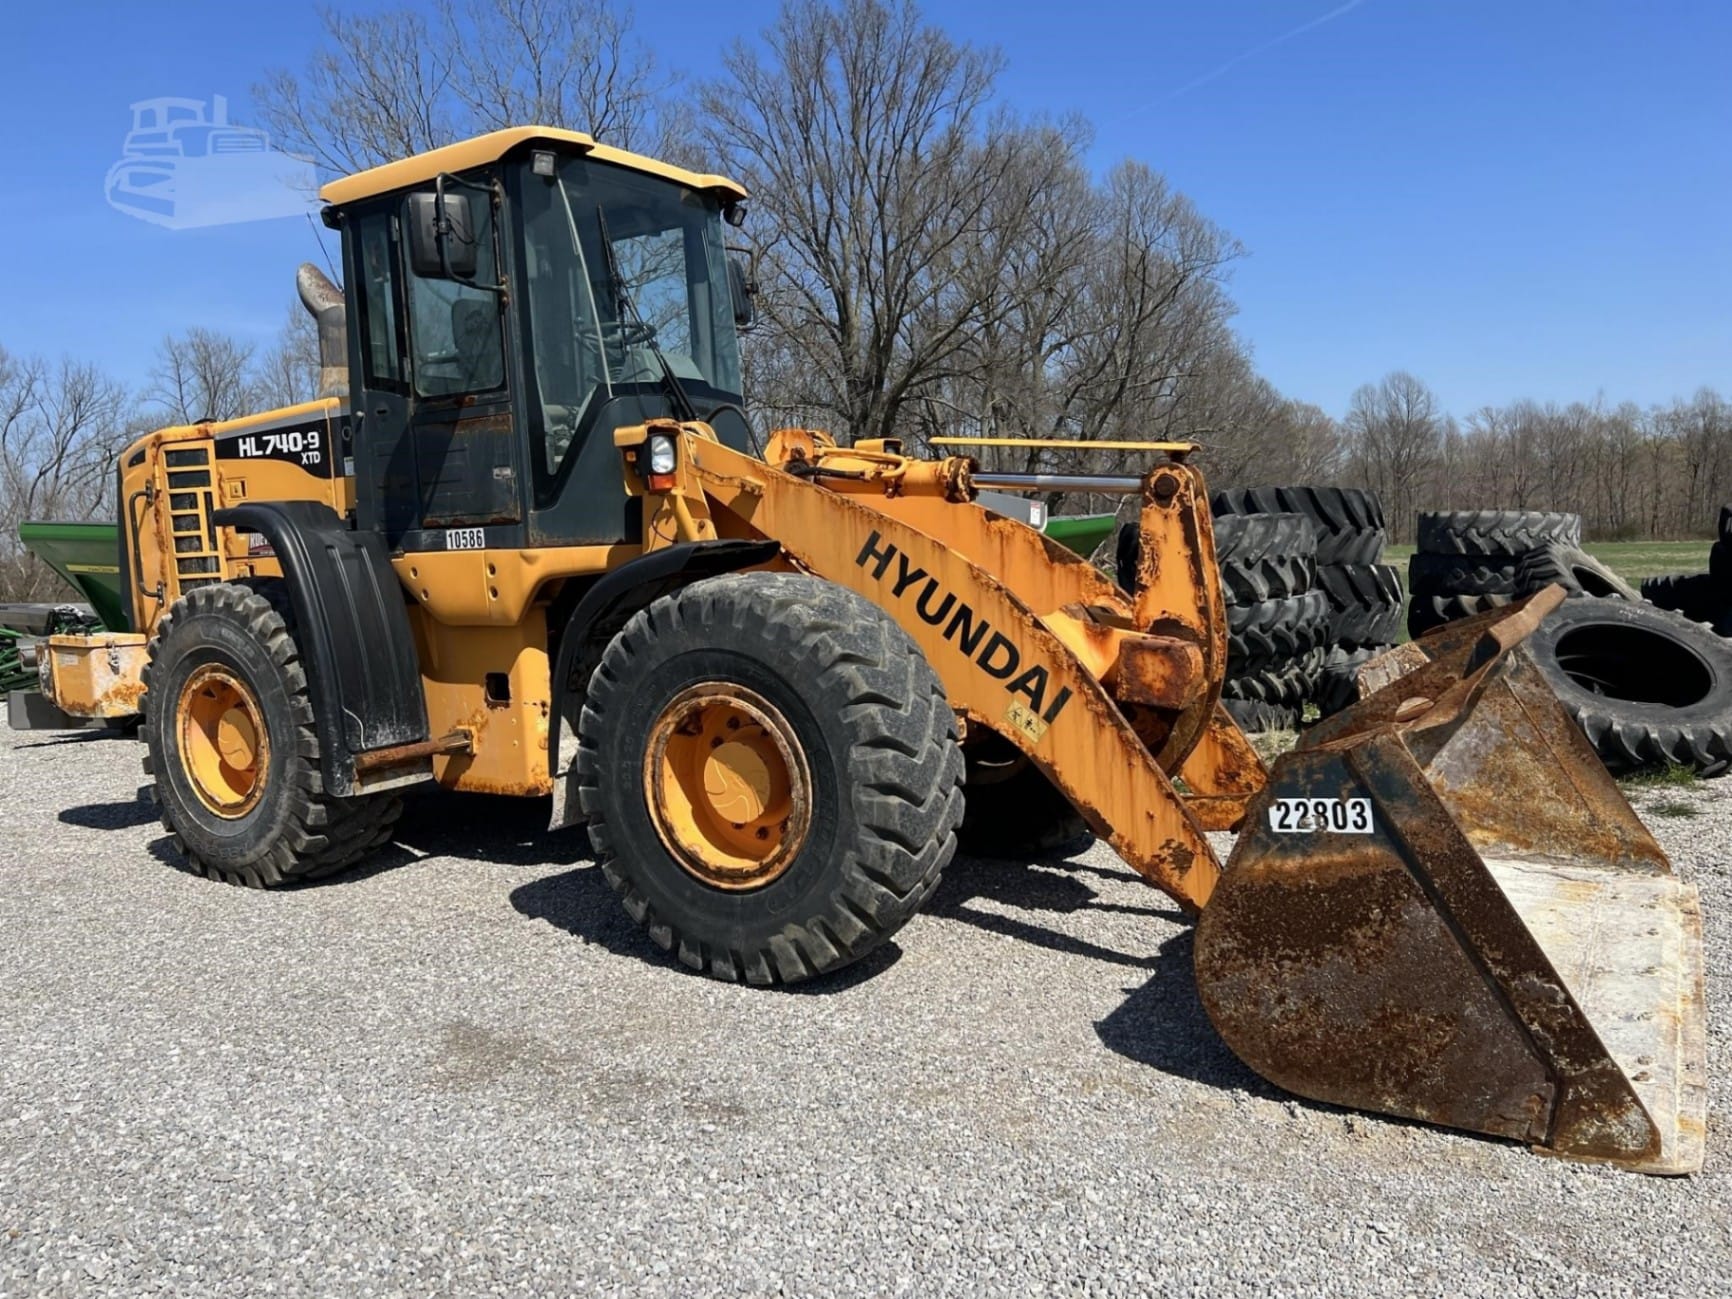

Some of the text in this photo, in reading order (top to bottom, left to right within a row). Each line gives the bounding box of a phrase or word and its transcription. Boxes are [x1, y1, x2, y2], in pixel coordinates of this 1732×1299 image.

[238, 431, 320, 457] HL740-9
[301, 451, 321, 465] XTD
[448, 529, 483, 548] 10586
[855, 530, 1073, 725] HYUNDAI
[1275, 800, 1368, 831] 22803
